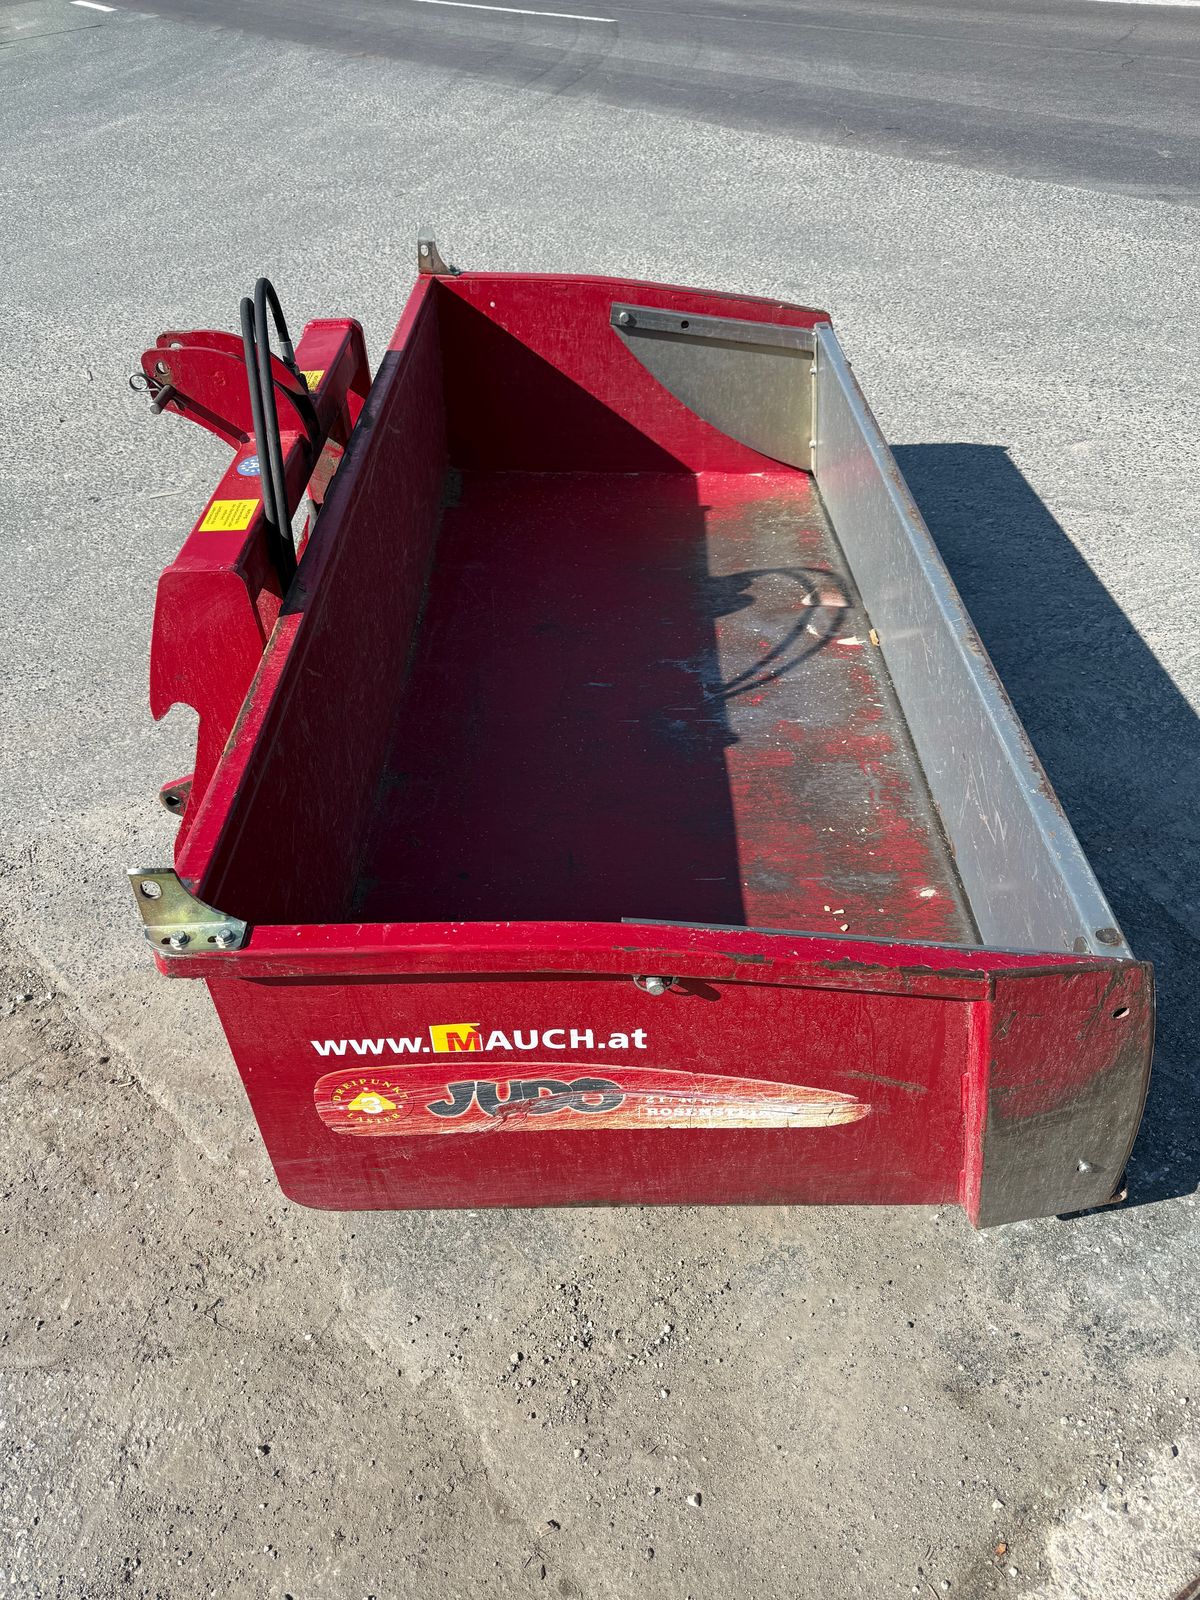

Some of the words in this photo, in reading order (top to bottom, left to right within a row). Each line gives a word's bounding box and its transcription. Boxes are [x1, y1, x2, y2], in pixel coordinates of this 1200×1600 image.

[310, 1026, 648, 1057] www.MAUCH.at
[332, 1078, 409, 1102] DREIPUNKT
[425, 1077, 625, 1118] JUDO
[359, 1096, 384, 1114] 3
